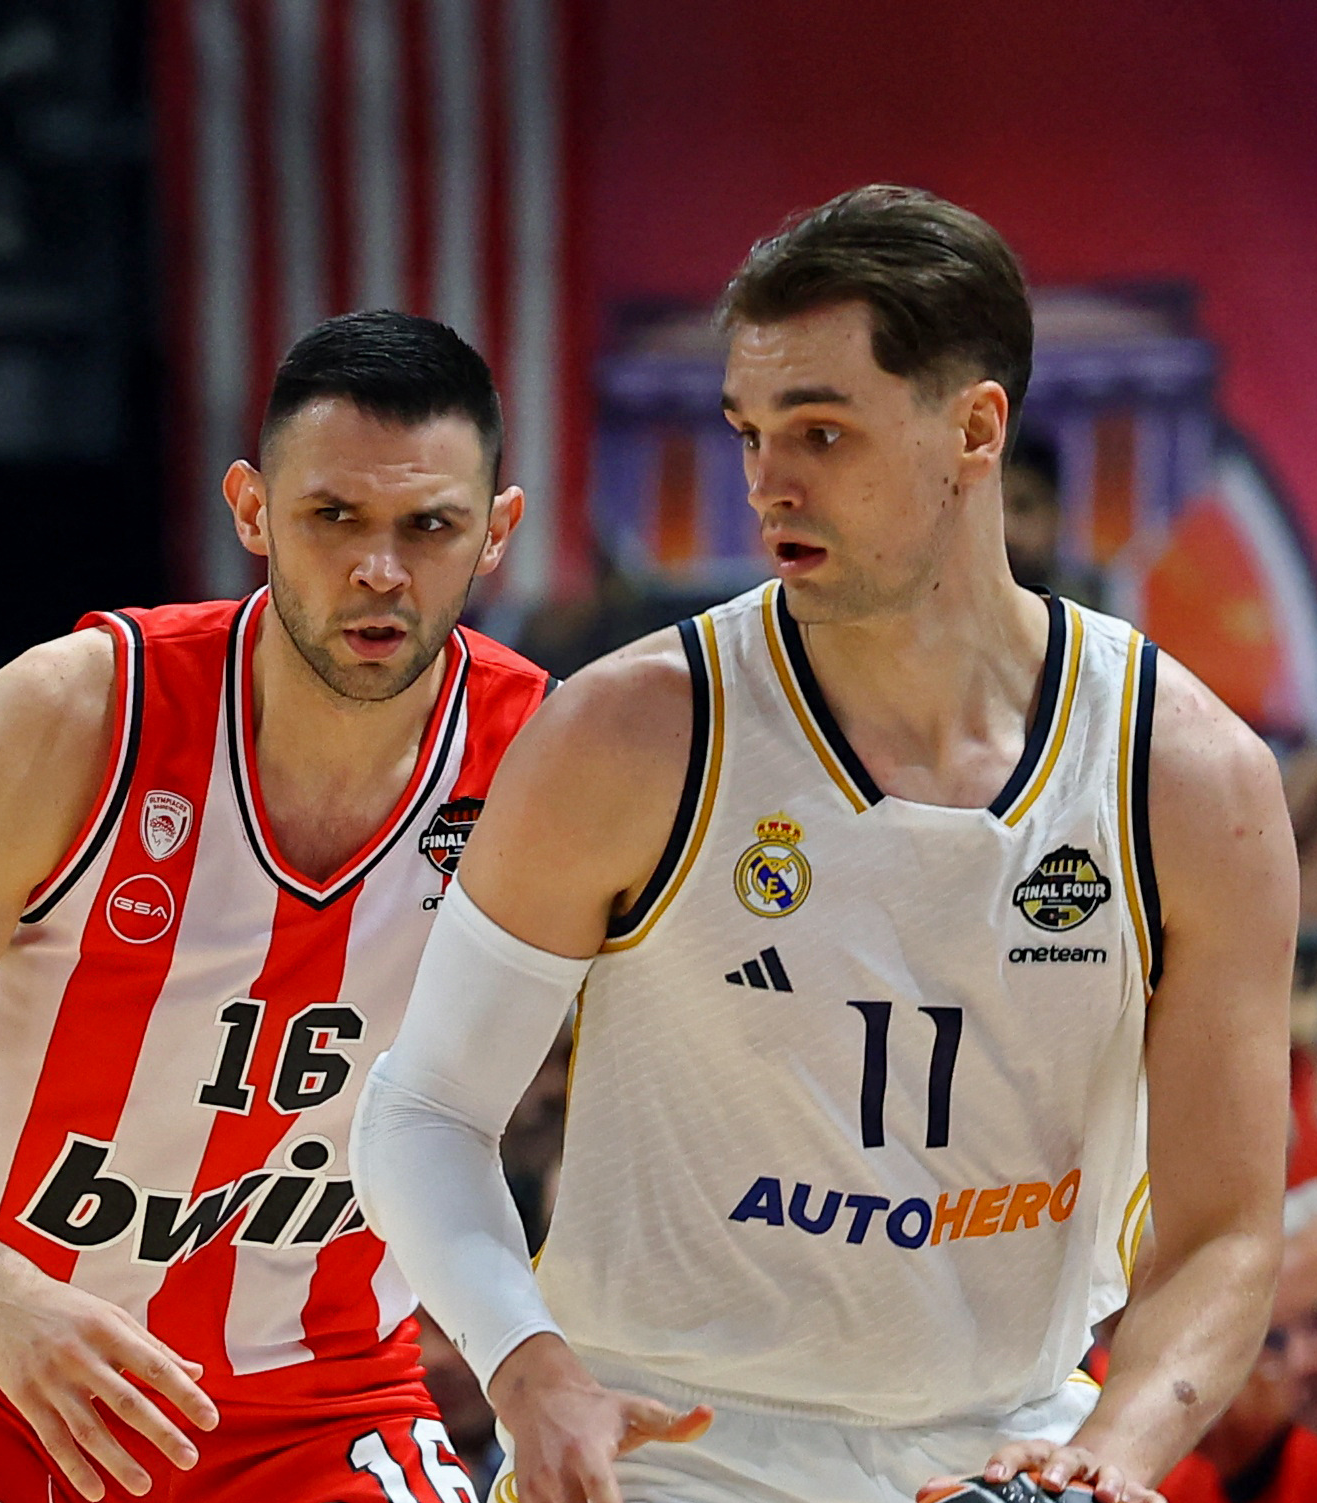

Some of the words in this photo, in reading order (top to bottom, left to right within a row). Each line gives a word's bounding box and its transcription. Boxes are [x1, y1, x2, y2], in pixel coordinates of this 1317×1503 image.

[422, 833, 466, 849] FINAL
[1016, 884, 1059, 902] FINAL
[1062, 883, 1106, 898] FOUR
[114, 897, 168, 920] GSA
[1008, 945, 1107, 963] oneteam
[192, 997, 368, 1116] 16
[846, 1001, 963, 1149] 11
[728, 1168, 1081, 1250] AUTOHERO
